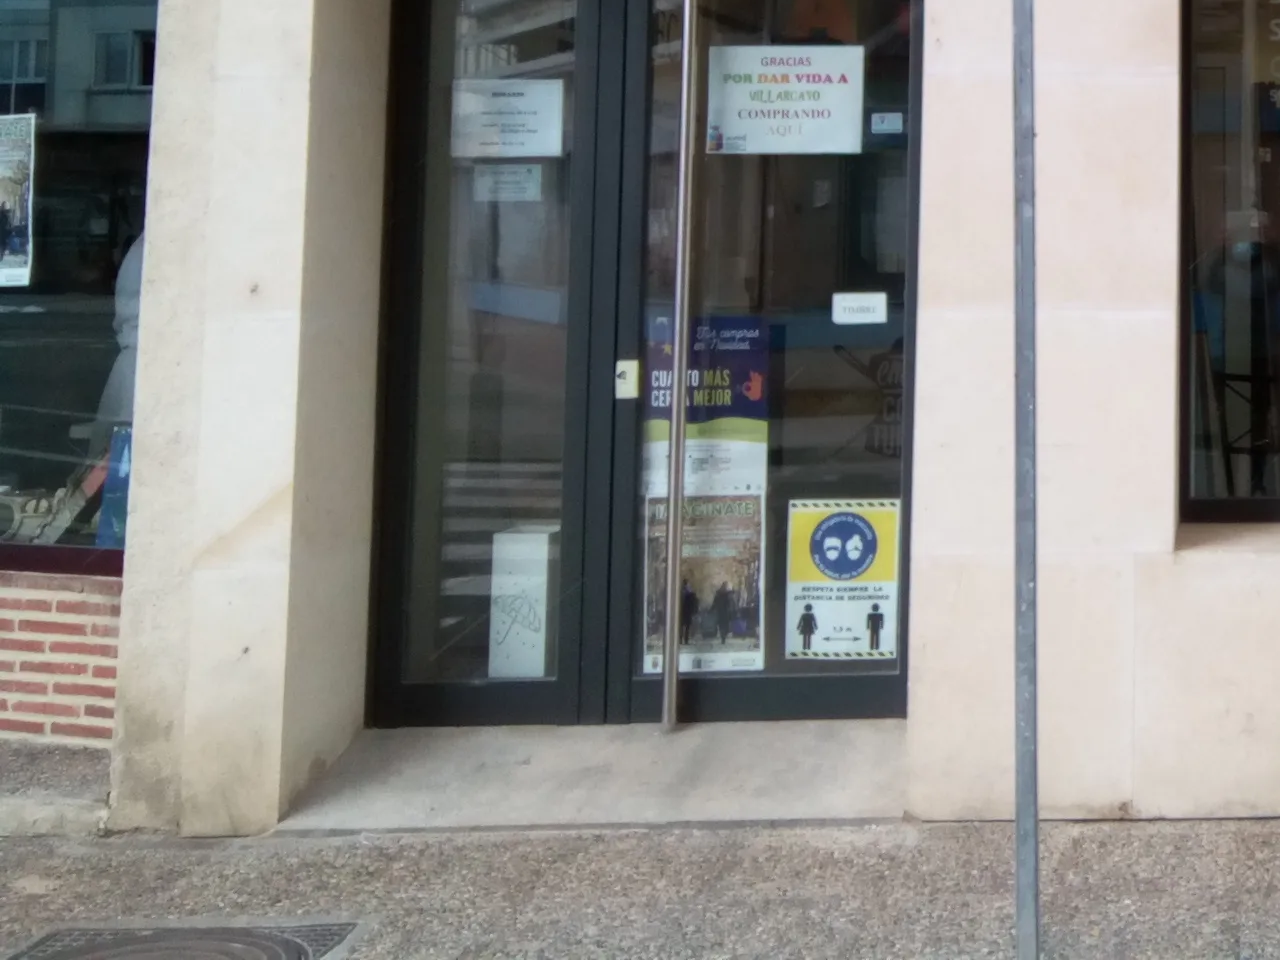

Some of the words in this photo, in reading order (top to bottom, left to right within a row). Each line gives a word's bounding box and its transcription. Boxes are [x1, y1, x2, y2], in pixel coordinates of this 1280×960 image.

[760, 56, 812, 67] GRACIAS
[723, 73, 751, 84] POR
[757, 73, 790, 84] DAR
[795, 73, 833, 84] VIDA
[837, 73, 849, 84] A
[737, 108, 832, 120] COMPRANDO
[651, 370, 699, 387] CUATO
[693, 390, 732, 406] MEJOR
